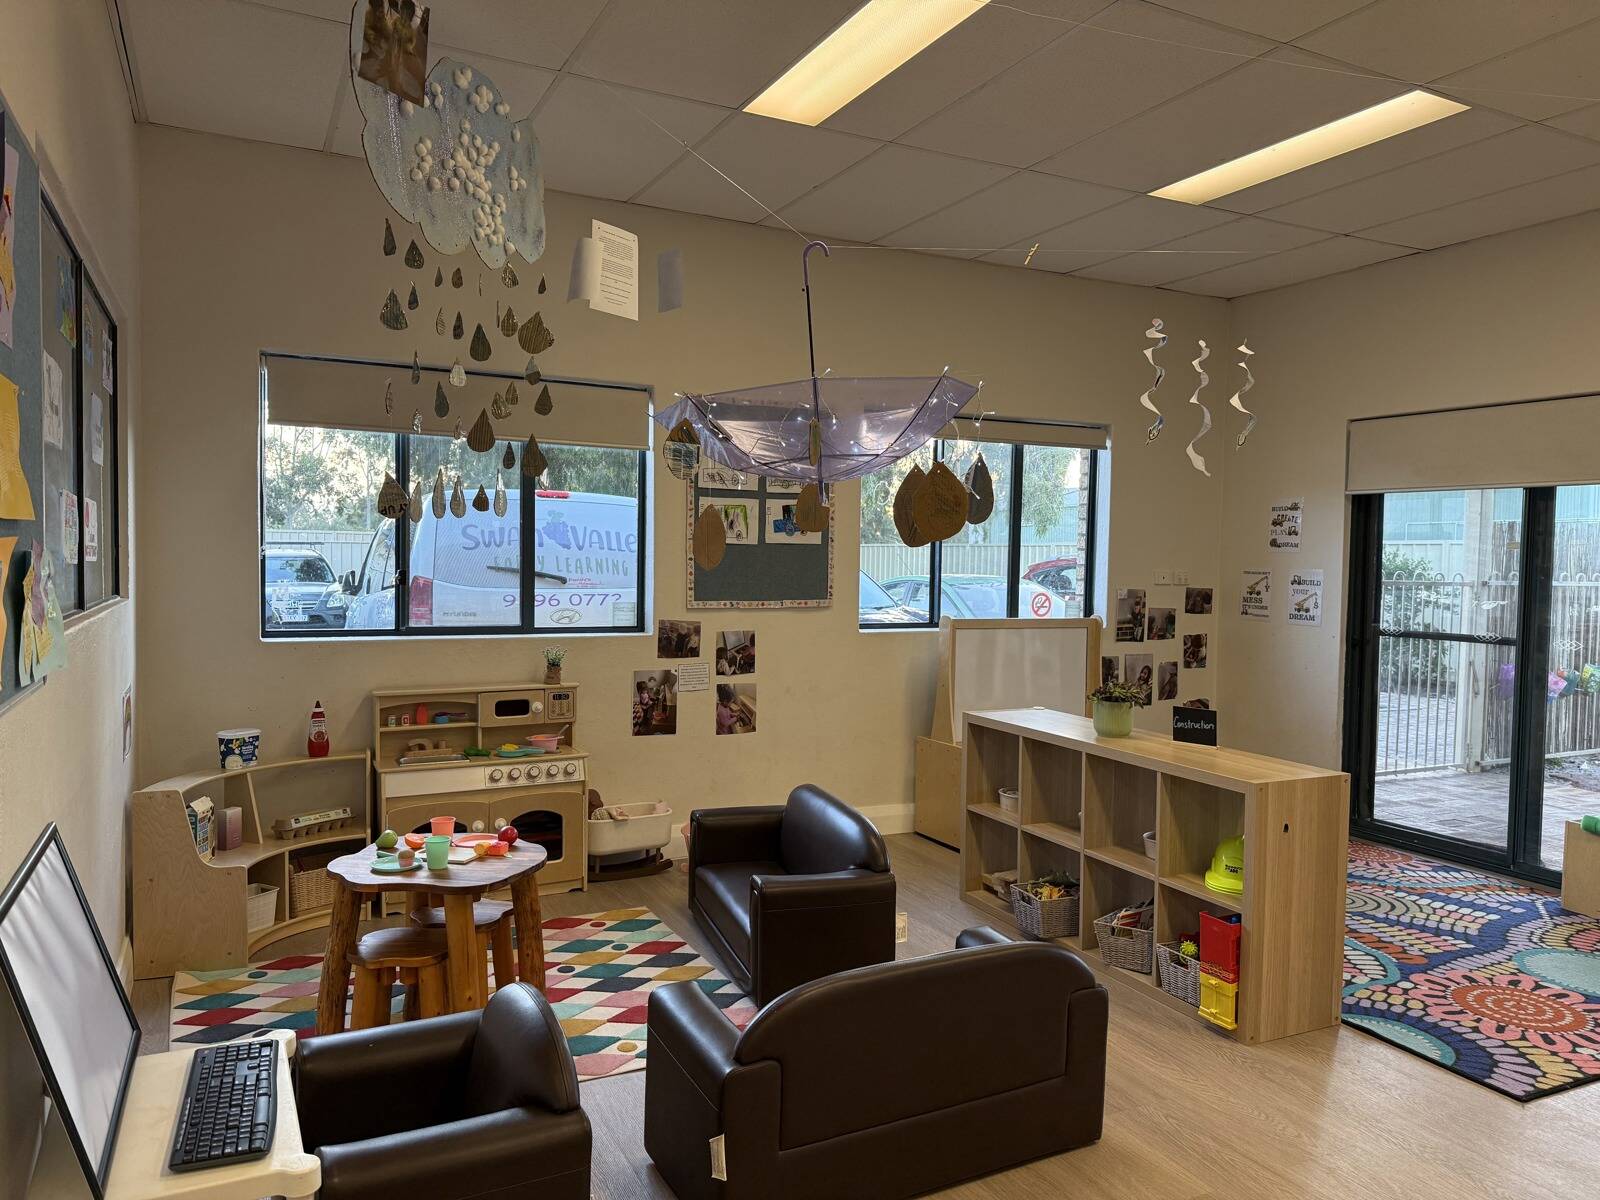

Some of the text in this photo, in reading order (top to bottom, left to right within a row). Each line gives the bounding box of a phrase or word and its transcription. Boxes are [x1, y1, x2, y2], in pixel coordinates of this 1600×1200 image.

[1276, 514, 1299, 524] CREATE
[555, 555, 630, 577] LEARNING
[1302, 579, 1321, 587] BUILD
[502, 594, 561, 608] 996
[1242, 596, 1262, 604] MESS
[1288, 613, 1316, 621] DREAM
[1173, 716, 1215, 730] Construction
